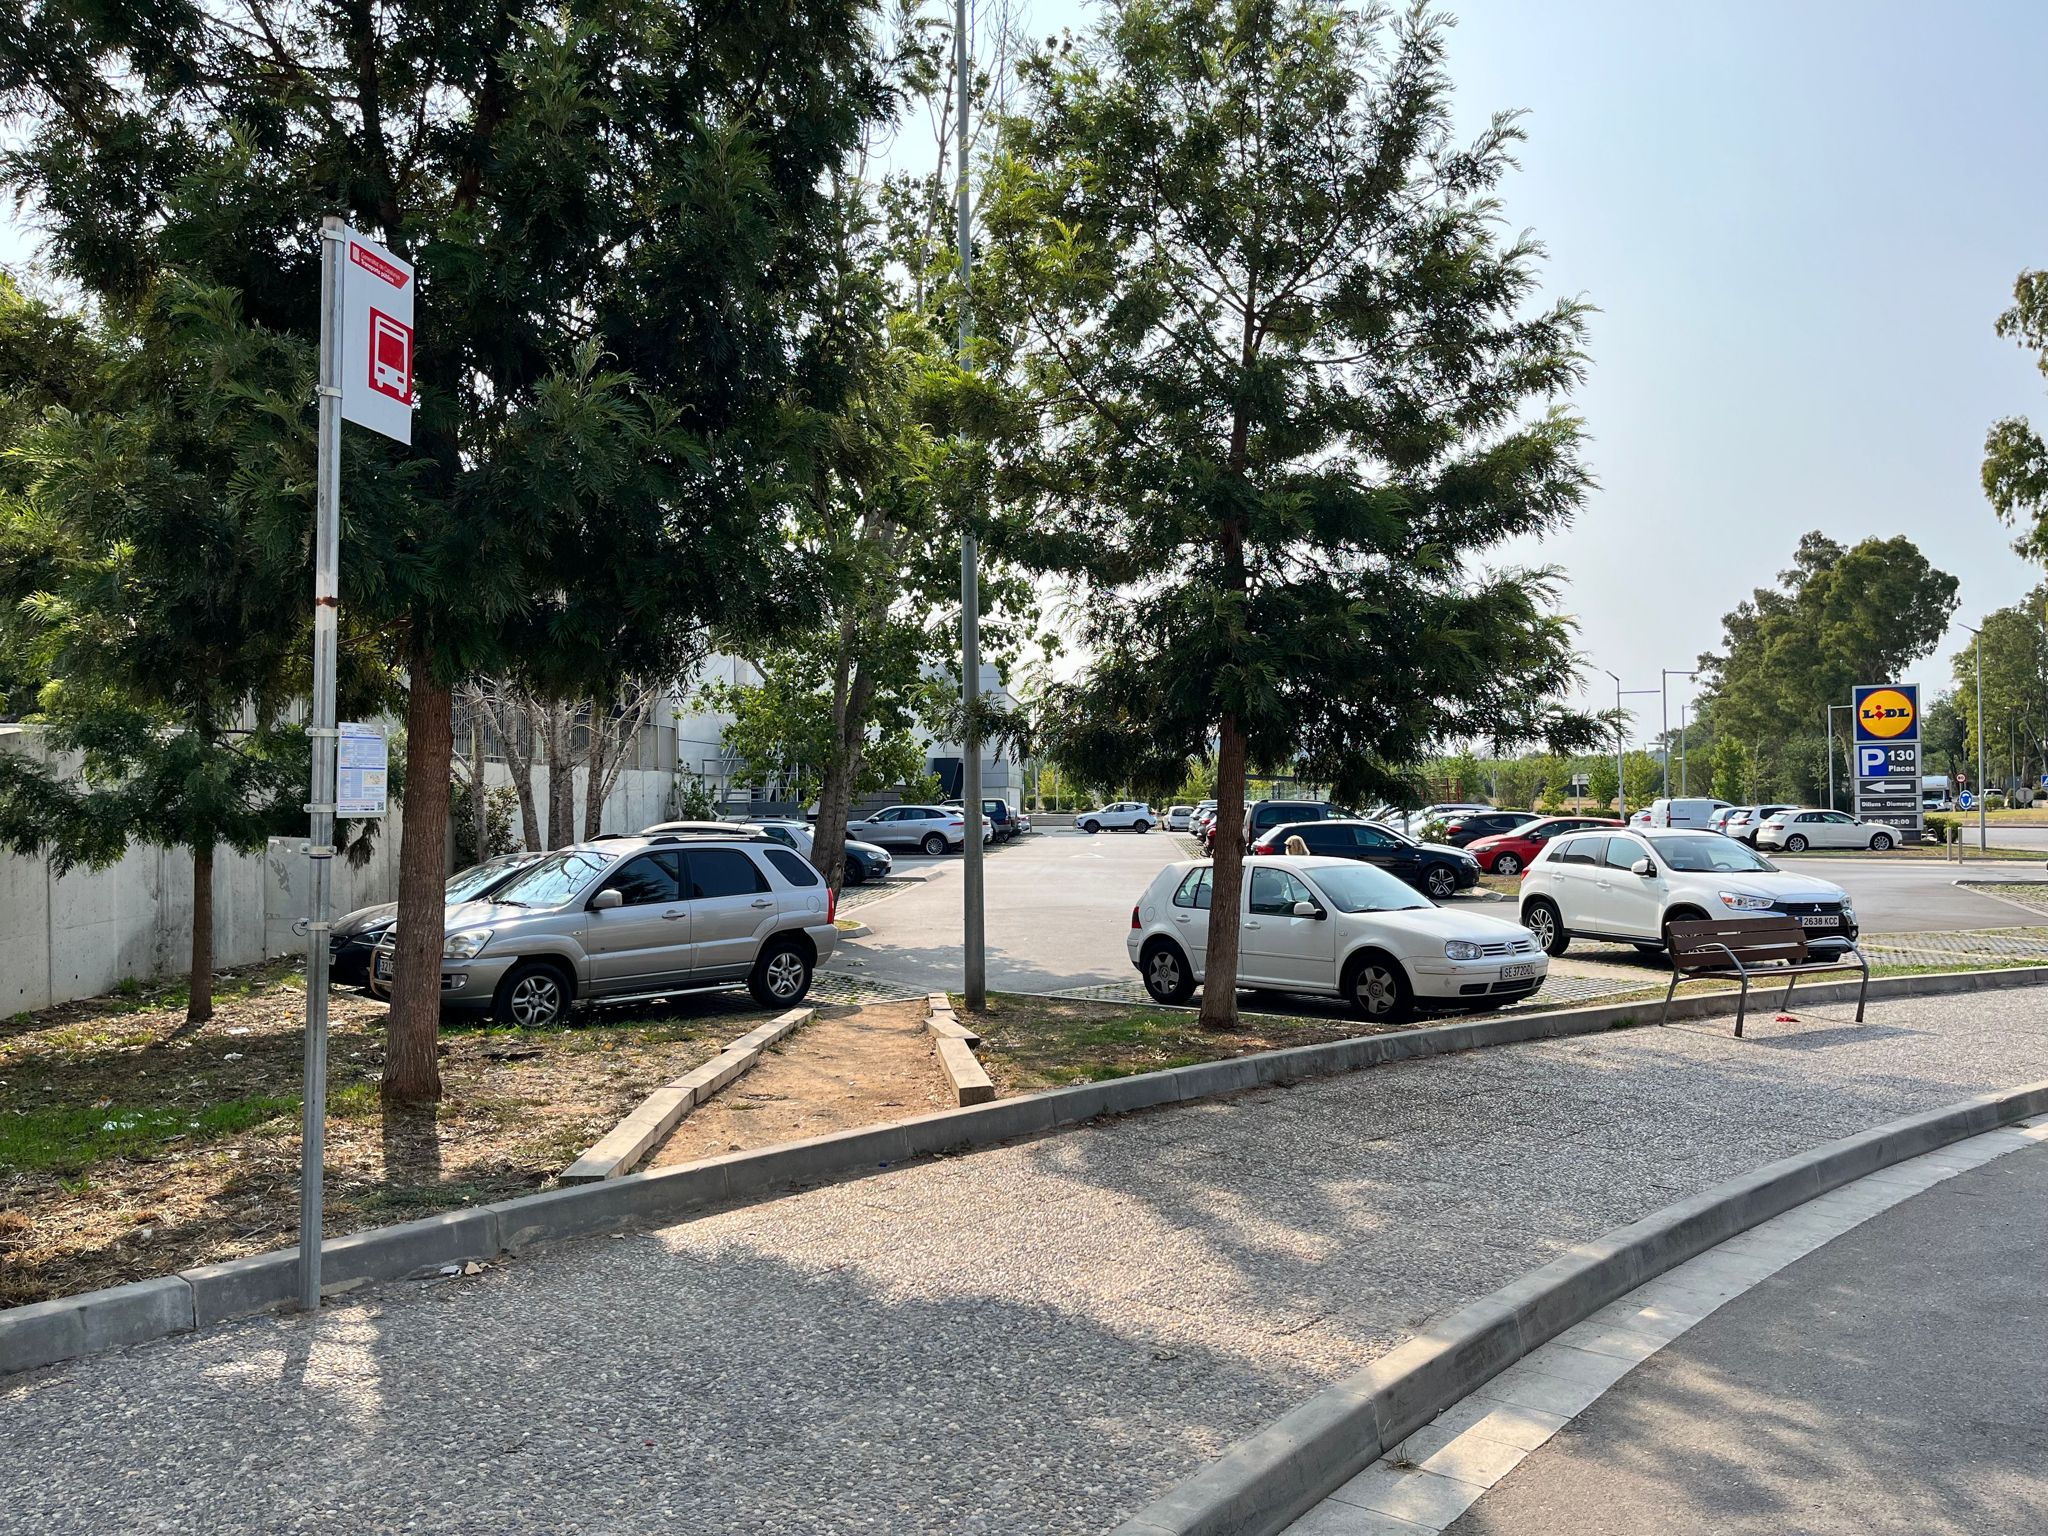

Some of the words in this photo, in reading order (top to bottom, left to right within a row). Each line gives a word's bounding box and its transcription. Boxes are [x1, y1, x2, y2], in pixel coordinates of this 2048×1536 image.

[1888, 749, 1915, 761] 130
[1861, 748, 1886, 776] P
[1888, 764, 1915, 772] Places
[1803, 917, 1823, 926] 2638
[1824, 917, 1838, 926] KCC
